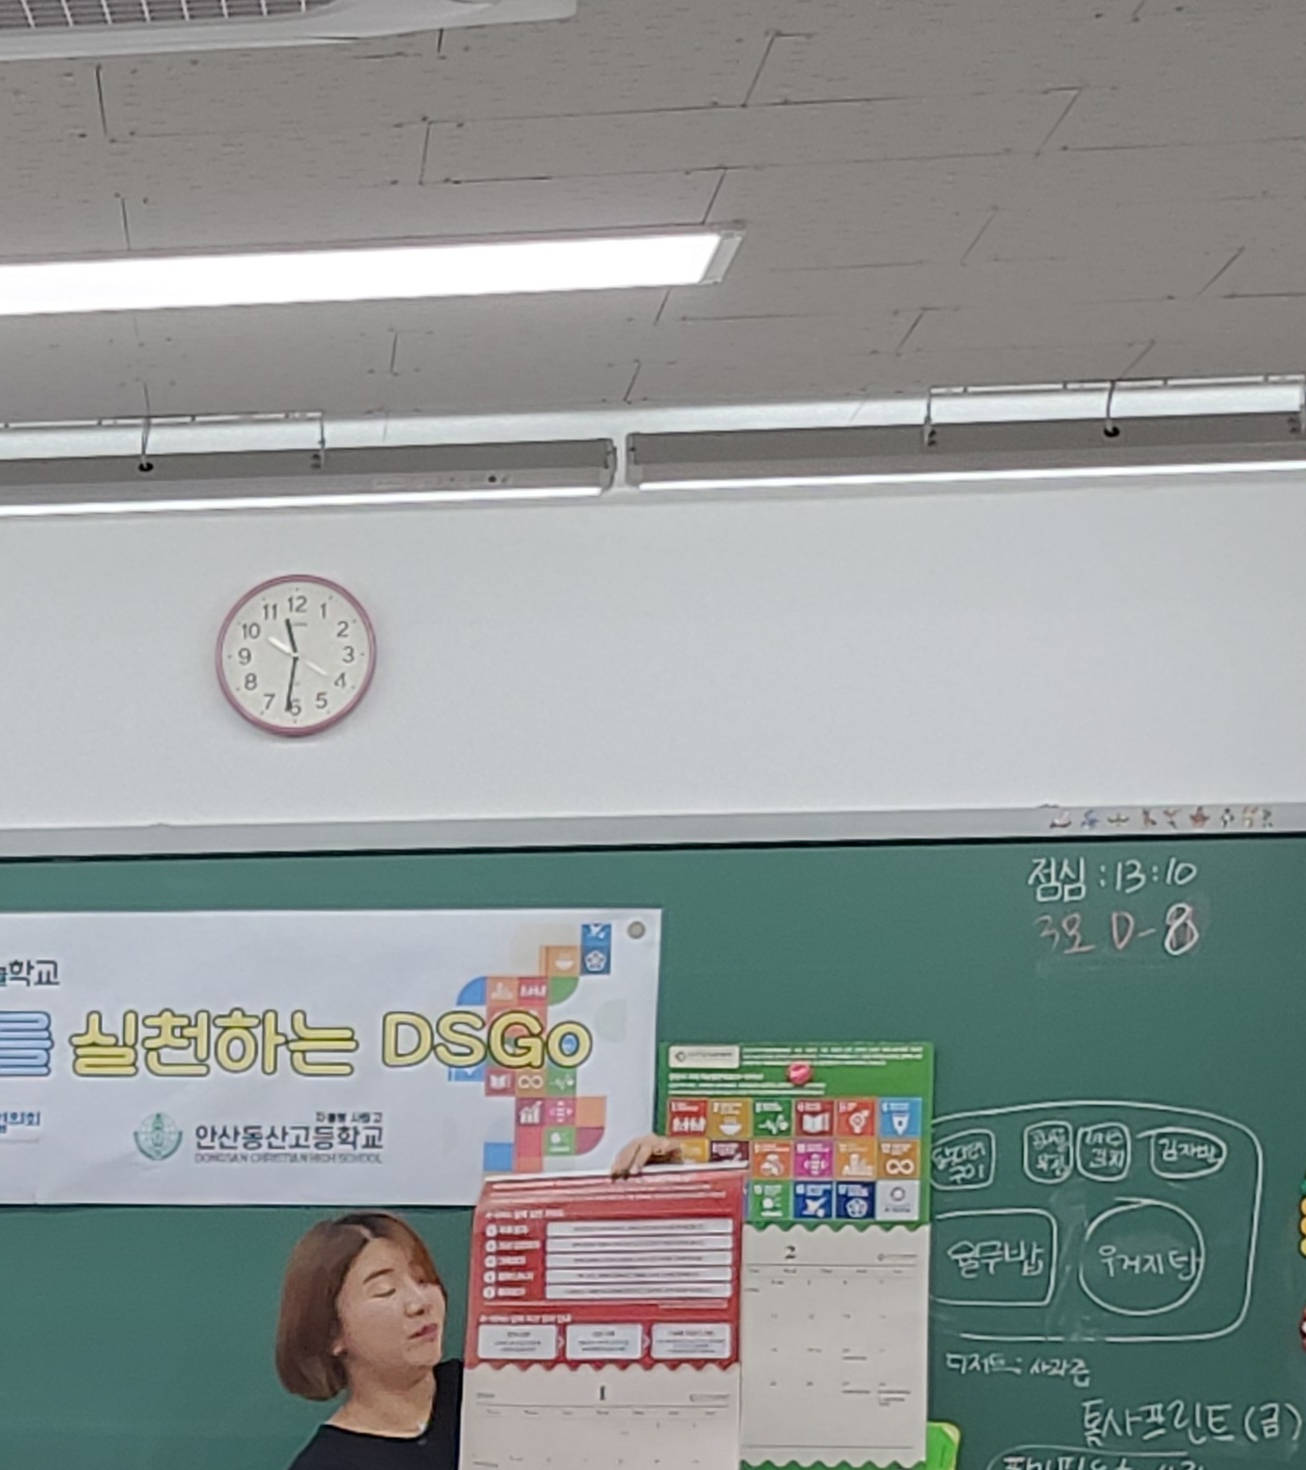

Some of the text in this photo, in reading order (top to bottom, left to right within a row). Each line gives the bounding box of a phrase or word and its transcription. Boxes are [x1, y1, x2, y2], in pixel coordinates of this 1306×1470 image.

[262, 603, 278, 621] 11
[287, 595, 308, 614] 12
[319, 602, 328, 620] 1
[242, 622, 261, 640] 10
[336, 620, 350, 638] 2
[237, 647, 252, 666] 9
[341, 646, 355, 664] 3
[244, 673, 258, 691] 8
[333, 672, 347, 689] 4
[263, 693, 276, 711] 7
[315, 692, 329, 709] 5
[1027, 856, 1087, 903] 점심
[70, 1006, 359, 1078] 실천하는
[381, 1009, 594, 1071] DSGo
[194, 1124, 384, 1151] 안산동산고등학교
[783, 1245, 798, 1260] 2
